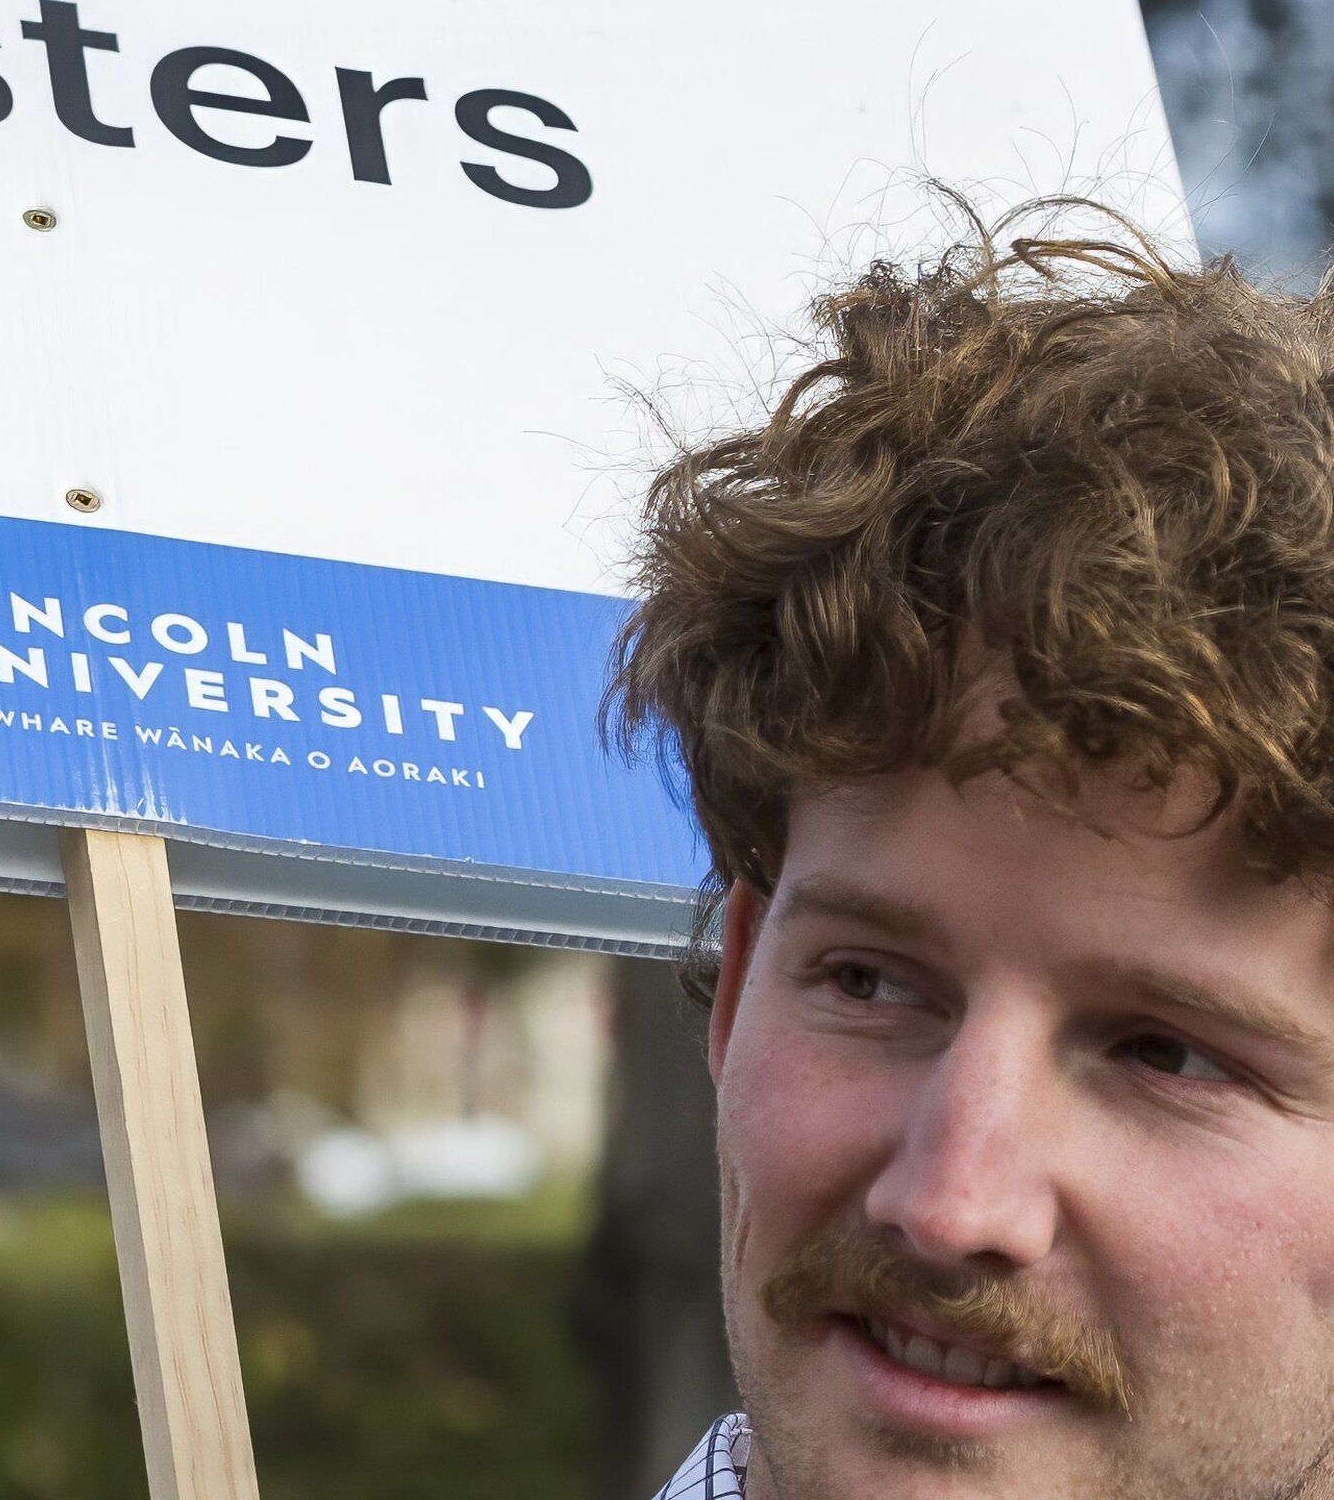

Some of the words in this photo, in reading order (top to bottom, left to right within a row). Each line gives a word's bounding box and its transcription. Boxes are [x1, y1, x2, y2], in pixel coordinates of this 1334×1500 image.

[134, 725, 291, 766] WĀNAKA
[307, 751, 331, 769] O
[348, 756, 485, 789] AORAKI
